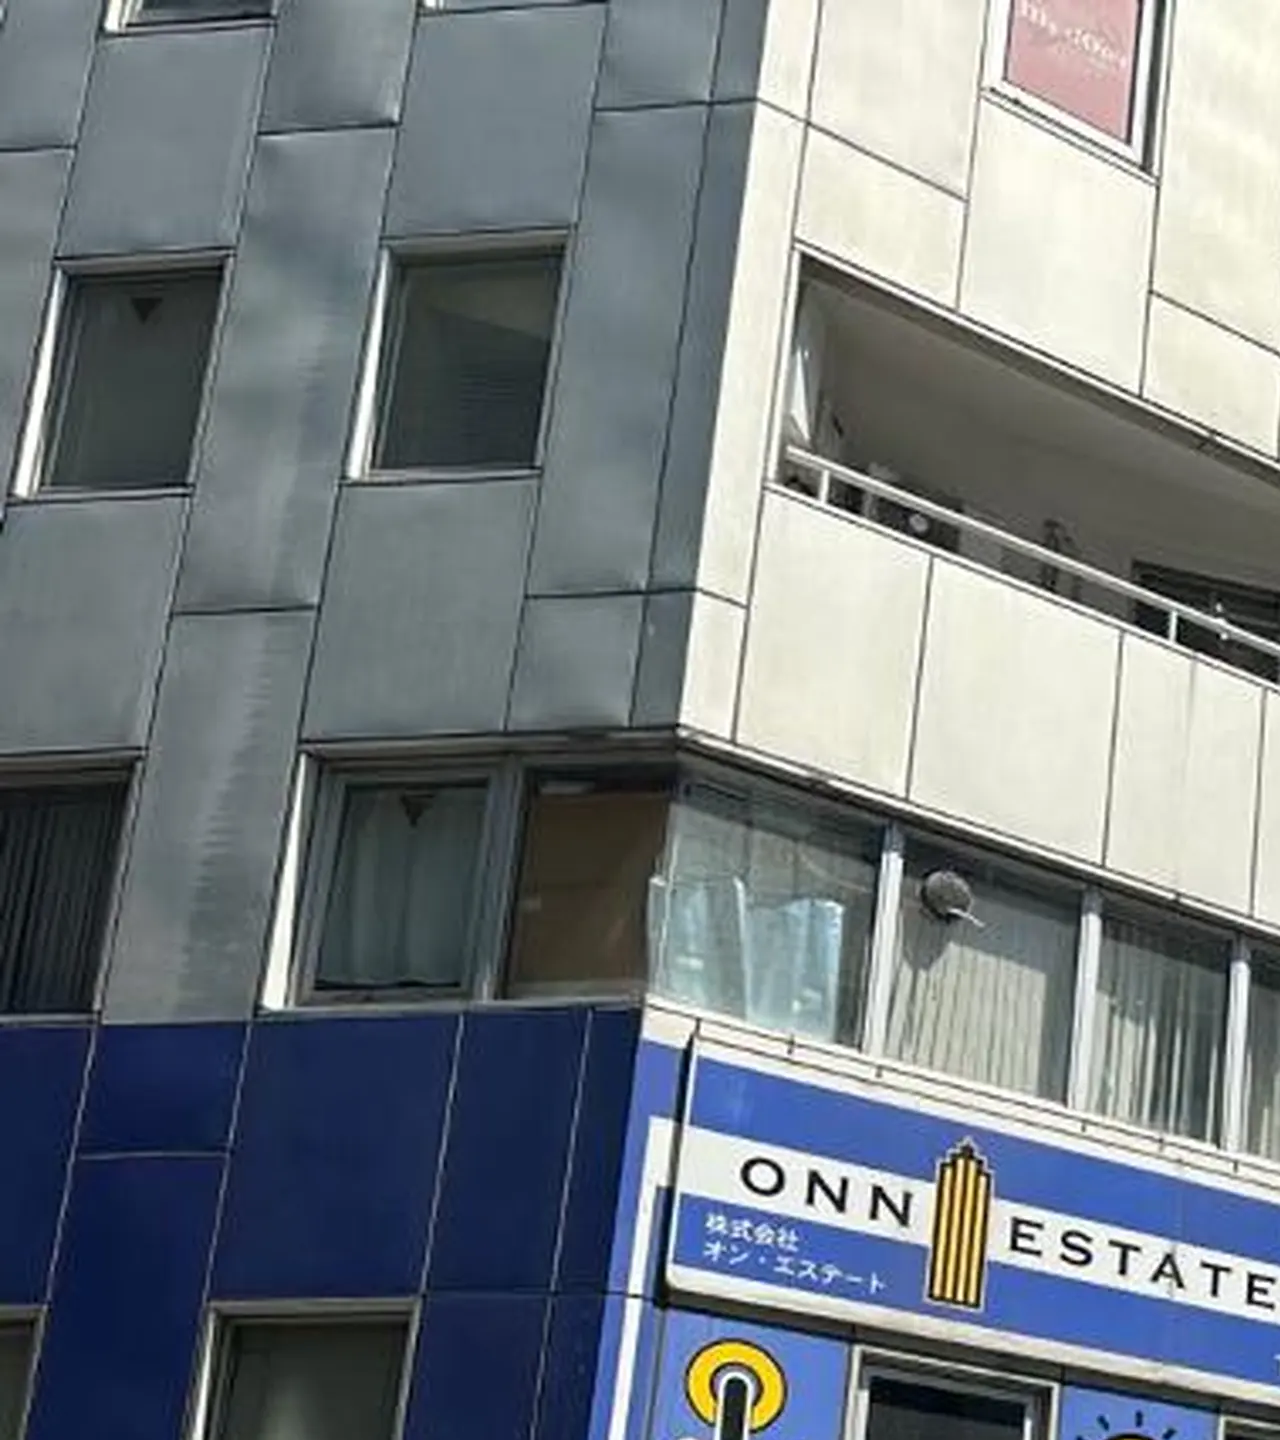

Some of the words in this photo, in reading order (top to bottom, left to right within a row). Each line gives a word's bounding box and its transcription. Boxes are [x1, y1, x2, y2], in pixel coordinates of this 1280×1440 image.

[705, 1212, 799, 1252] 株式会社
[740, 1157, 914, 1228] ONN
[1009, 1217, 1277, 1310] ESTATE
[703, 1240, 887, 1295] オン・エステート
